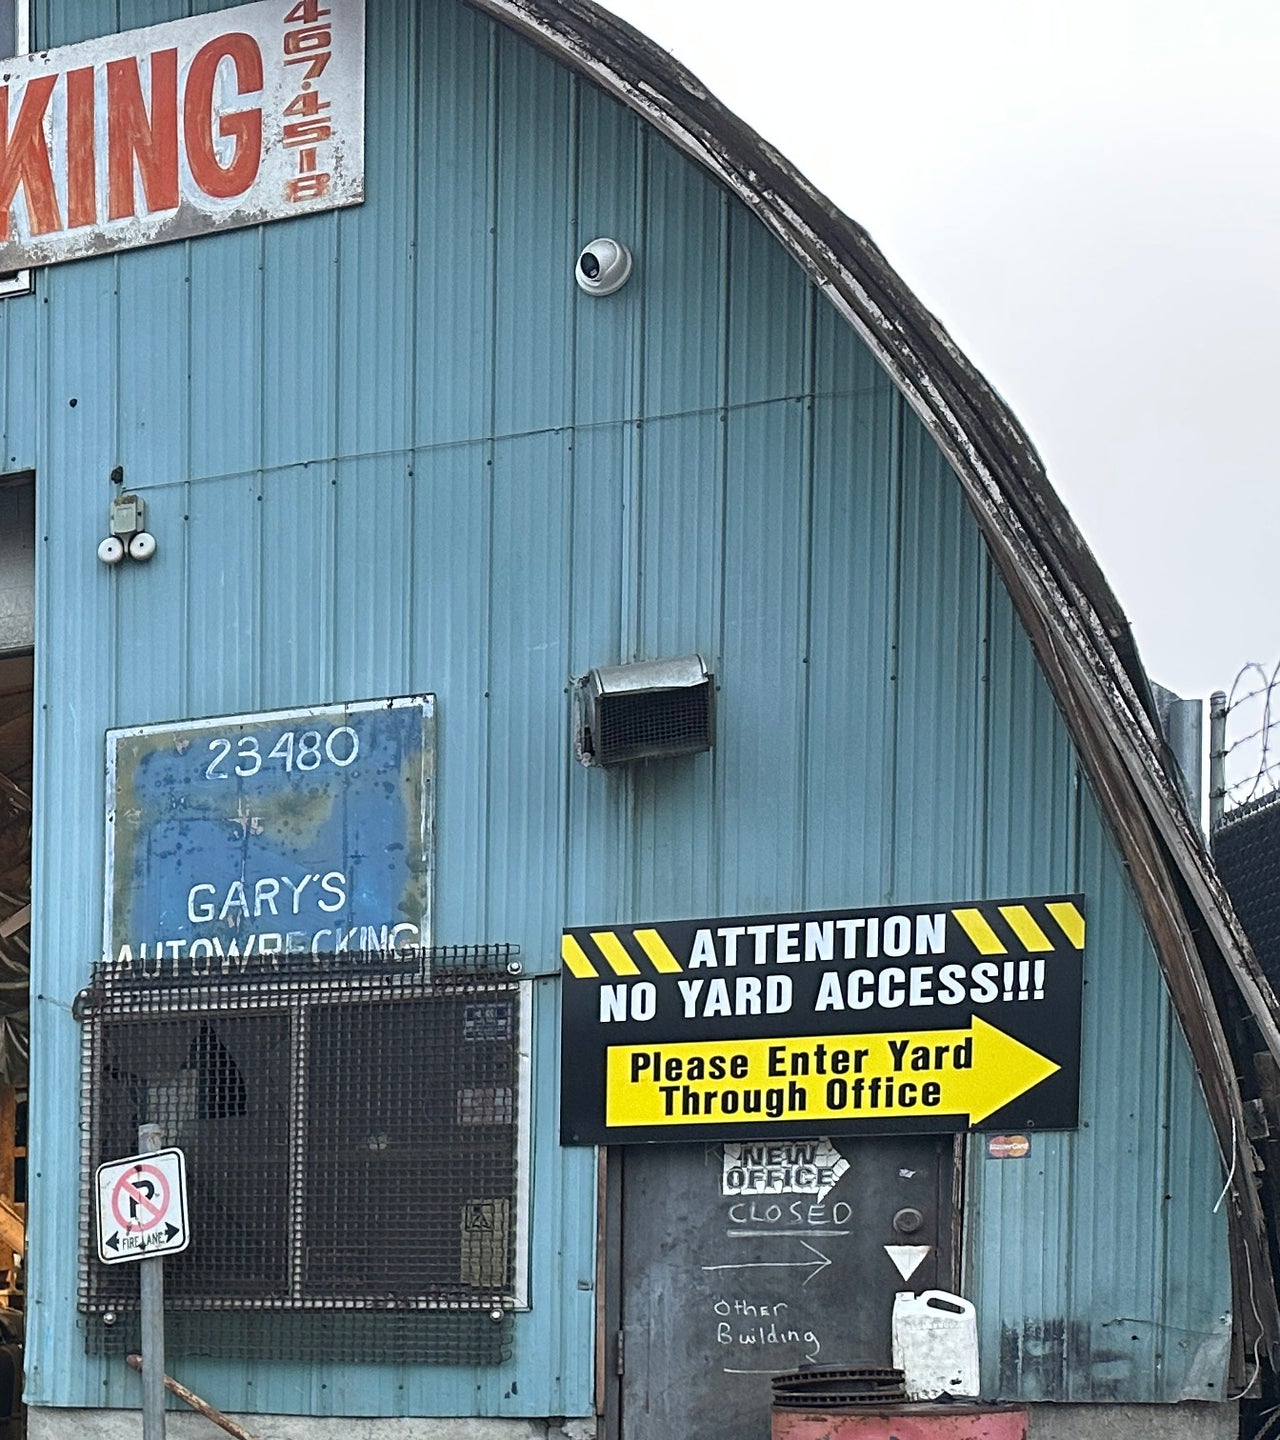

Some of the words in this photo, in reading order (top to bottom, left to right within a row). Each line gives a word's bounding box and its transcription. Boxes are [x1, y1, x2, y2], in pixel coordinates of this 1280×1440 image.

[205, 726, 359, 780] 23480
[187, 871, 348, 924] GARY'S
[688, 912, 947, 970] ATTENTION
[599, 982, 657, 1023] NO
[677, 974, 793, 1018] YARD
[815, 959, 1046, 1012] ACCESS!!!
[630, 1049, 748, 1083] Please
[768, 1045, 869, 1077] Enter
[889, 1036, 974, 1072] Yard
[659, 1082, 807, 1118] Through
[825, 1076, 941, 1111] Office
[740, 1143, 817, 1168] NEW
[726, 1166, 836, 1189] OFFICE
[728, 1200, 852, 1226] CLOSED
[122, 1235, 140, 1250] FIRE
[717, 1322, 821, 1357] Building
